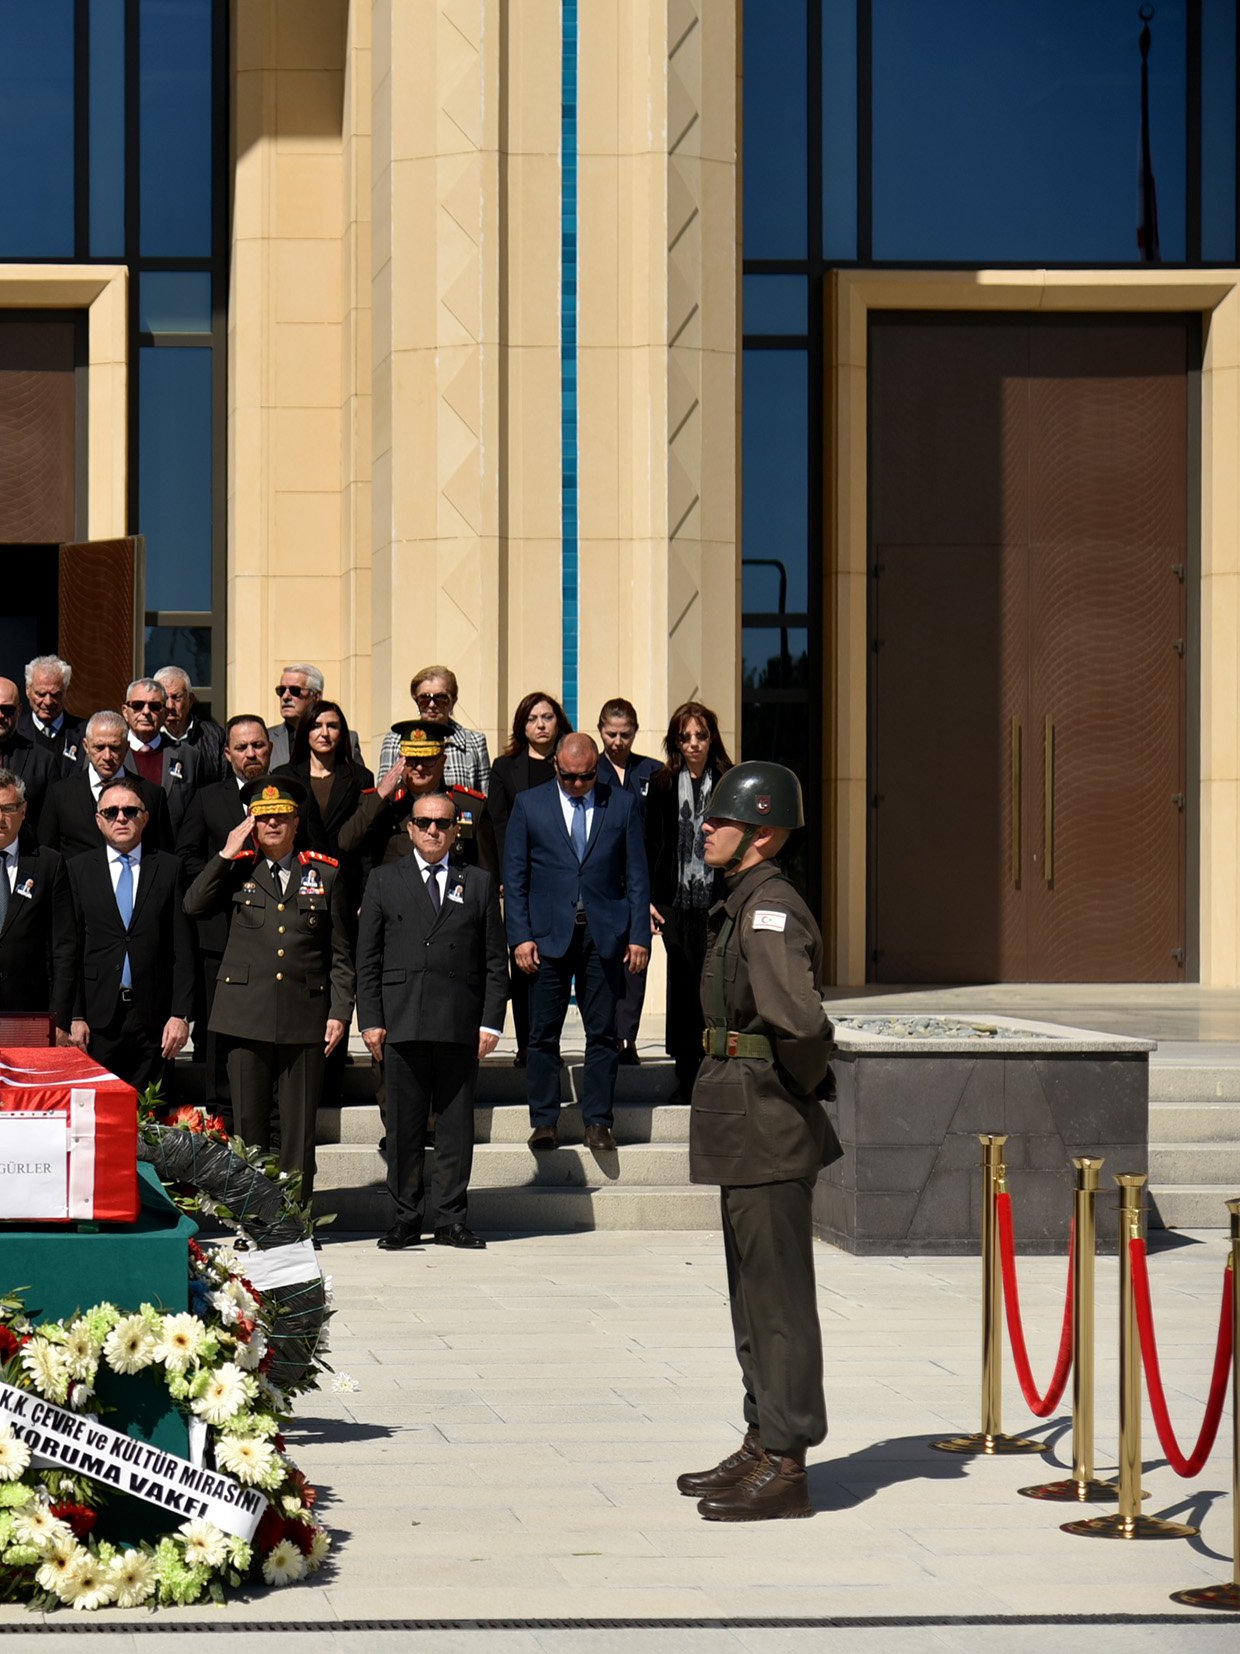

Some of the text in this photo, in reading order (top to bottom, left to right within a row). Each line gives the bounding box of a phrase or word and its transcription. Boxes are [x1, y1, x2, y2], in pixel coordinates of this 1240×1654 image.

[0, 1389, 261, 1515] K.K. ÇEVRE ve KÜLTÜR MİRASINI
